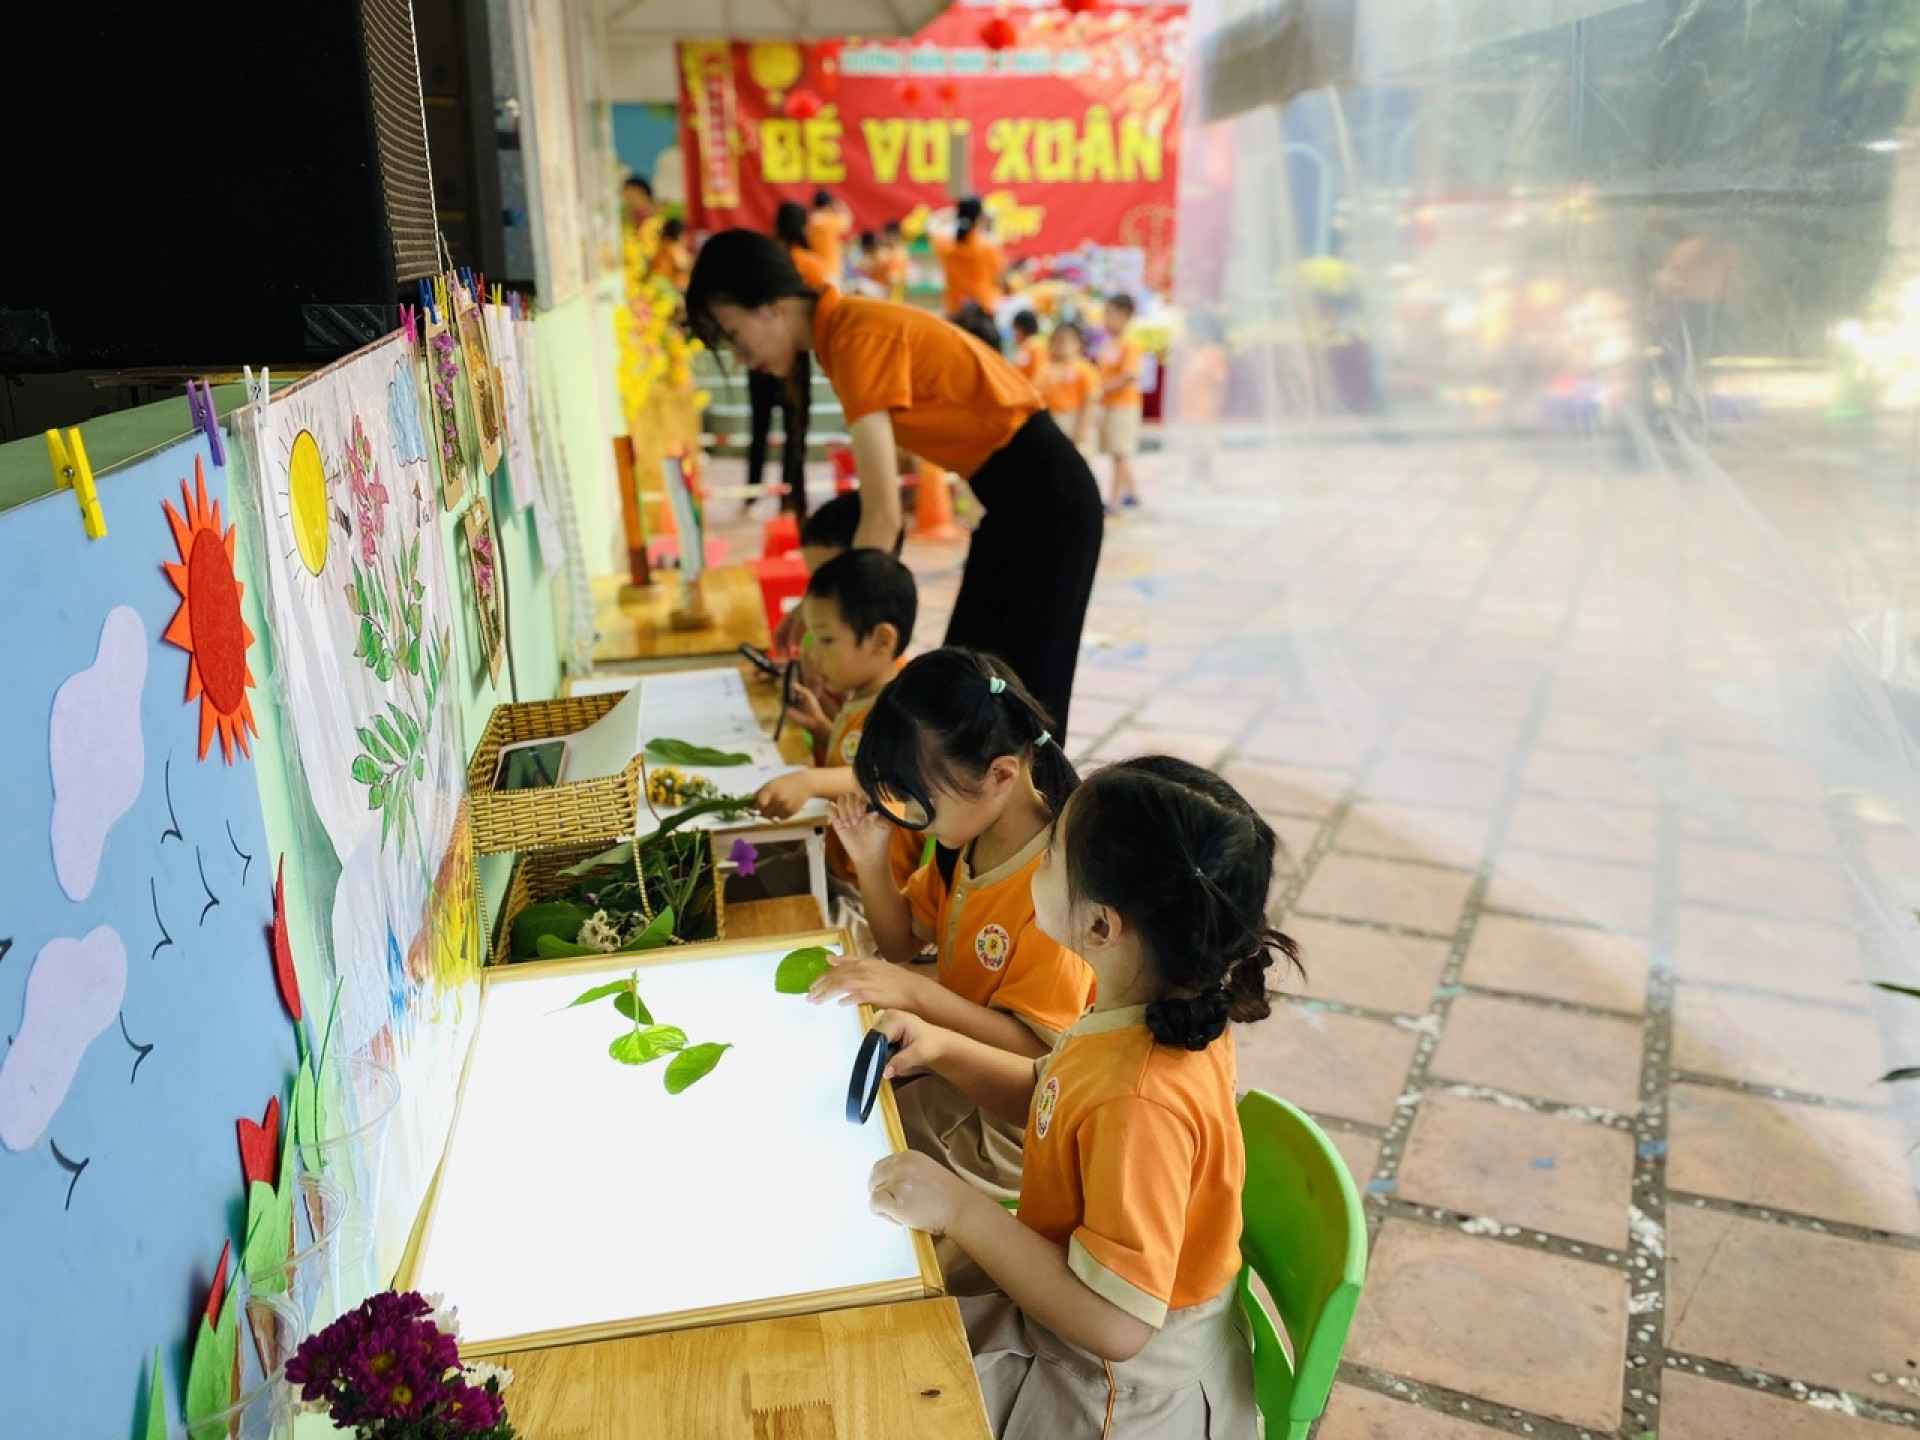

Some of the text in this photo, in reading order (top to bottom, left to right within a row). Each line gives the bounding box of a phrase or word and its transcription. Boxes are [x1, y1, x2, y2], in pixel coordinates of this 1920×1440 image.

[760, 105, 847, 184] BÉ
[861, 117, 971, 184] VU
[988, 104, 1165, 183] XUÂN
